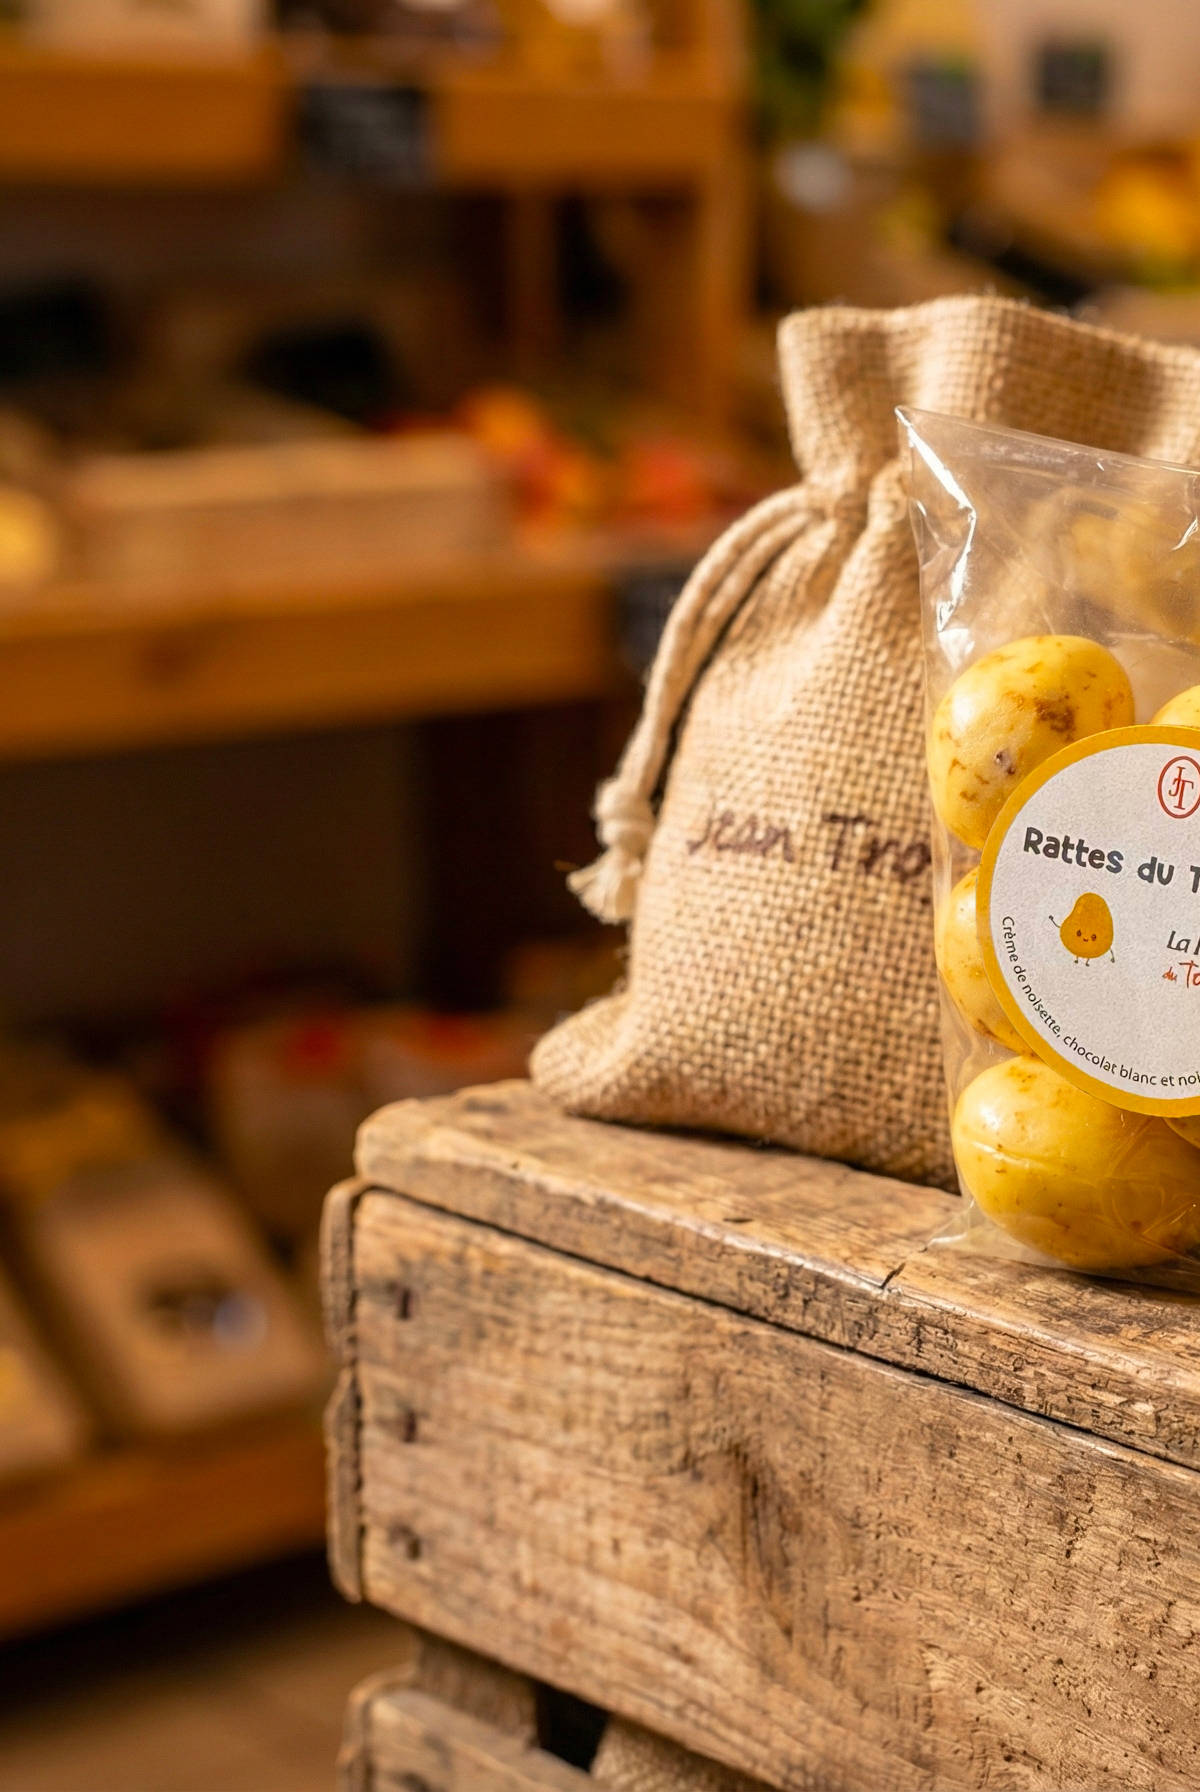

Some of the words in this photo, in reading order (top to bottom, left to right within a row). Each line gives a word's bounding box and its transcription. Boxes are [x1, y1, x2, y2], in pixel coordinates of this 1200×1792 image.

[1023, 827, 1124, 873] Rattes
[1137, 857, 1174, 885] du
[1166, 931, 1191, 953] La
[1162, 966, 1177, 982] du
[1002, 916, 1019, 962] Crème
[1013, 965, 1027, 983] de
[1022, 984, 1061, 1038] noisette,
[1063, 1035, 1117, 1074] chocolat
[1119, 1065, 1157, 1085] blanc
[1160, 1075, 1175, 1086] et
